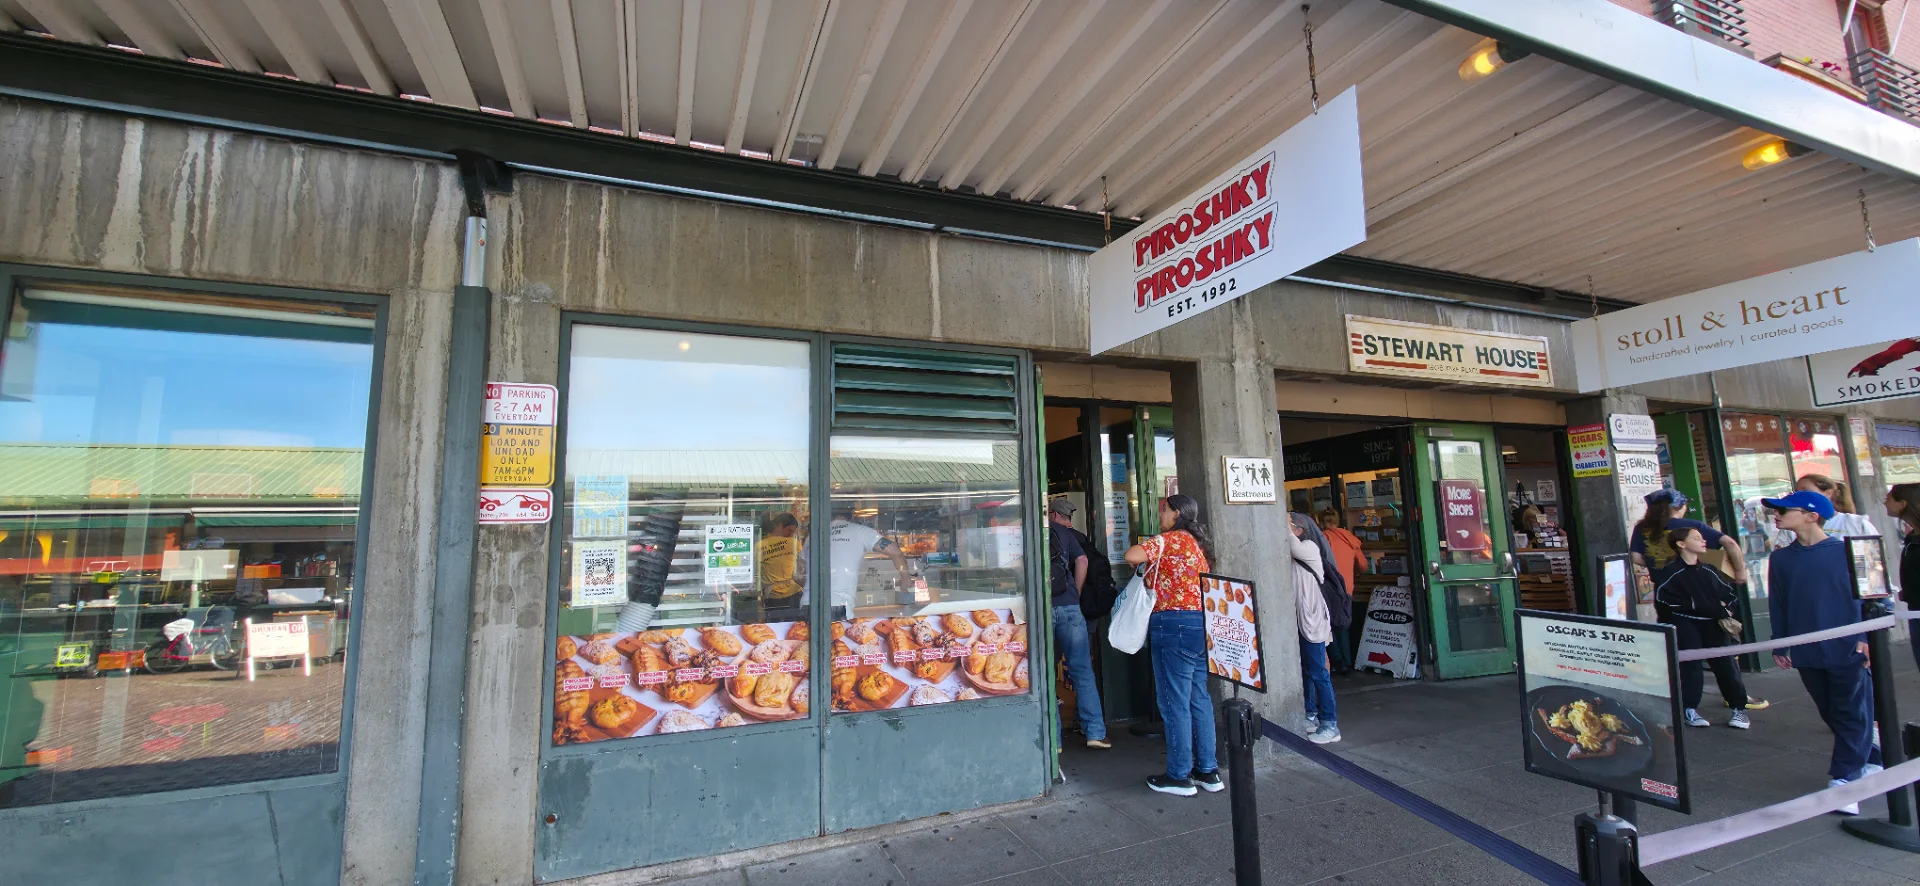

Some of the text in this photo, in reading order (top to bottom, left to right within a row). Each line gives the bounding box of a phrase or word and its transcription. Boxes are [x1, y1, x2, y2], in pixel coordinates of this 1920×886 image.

[1136, 161, 1271, 267] PIROSHKY
[1137, 212, 1273, 307] PIROSHKY
[1168, 278, 1236, 318] EST. 1992
[1617, 286, 1850, 350] stoll & heart
[1629, 345, 1691, 364] handcrafted
[1694, 338, 1735, 354] jewelry
[1750, 324, 1797, 342] curated
[1801, 316, 1844, 334] goods
[1363, 334, 1539, 370] STEWART HOUSE
[486, 387, 546, 399] NO PARKING
[1838, 376, 1920, 398] SMOKED
[493, 401, 542, 413] 2-7 AM
[496, 412, 538, 421] EVERYDAY
[506, 427, 544, 436] MINUTE
[490, 438, 540, 448] LOAD AND
[1571, 432, 1604, 444] CIGARS
[495, 447, 535, 456] UNLOAD
[1363, 439, 1394, 452] SINCE
[501, 456, 528, 465] ONLY
[1371, 452, 1390, 463] 1977
[493, 466, 535, 475] 7AM-6PM
[1293, 461, 1327, 474] SALMON
[1575, 460, 1608, 470] CIGARETTES
[1619, 458, 1657, 472] STEWART
[1624, 475, 1655, 485] HOUSE
[1231, 489, 1272, 499] Restrooms
[1446, 486, 1472, 500] MORE
[1449, 502, 1473, 516] SHOPS
[1374, 590, 1412, 600] TOBACC
[1381, 599, 1406, 607] PATCH
[1373, 611, 1407, 622] CIGARS
[1546, 625, 1635, 644] OSCAR'S STAR
